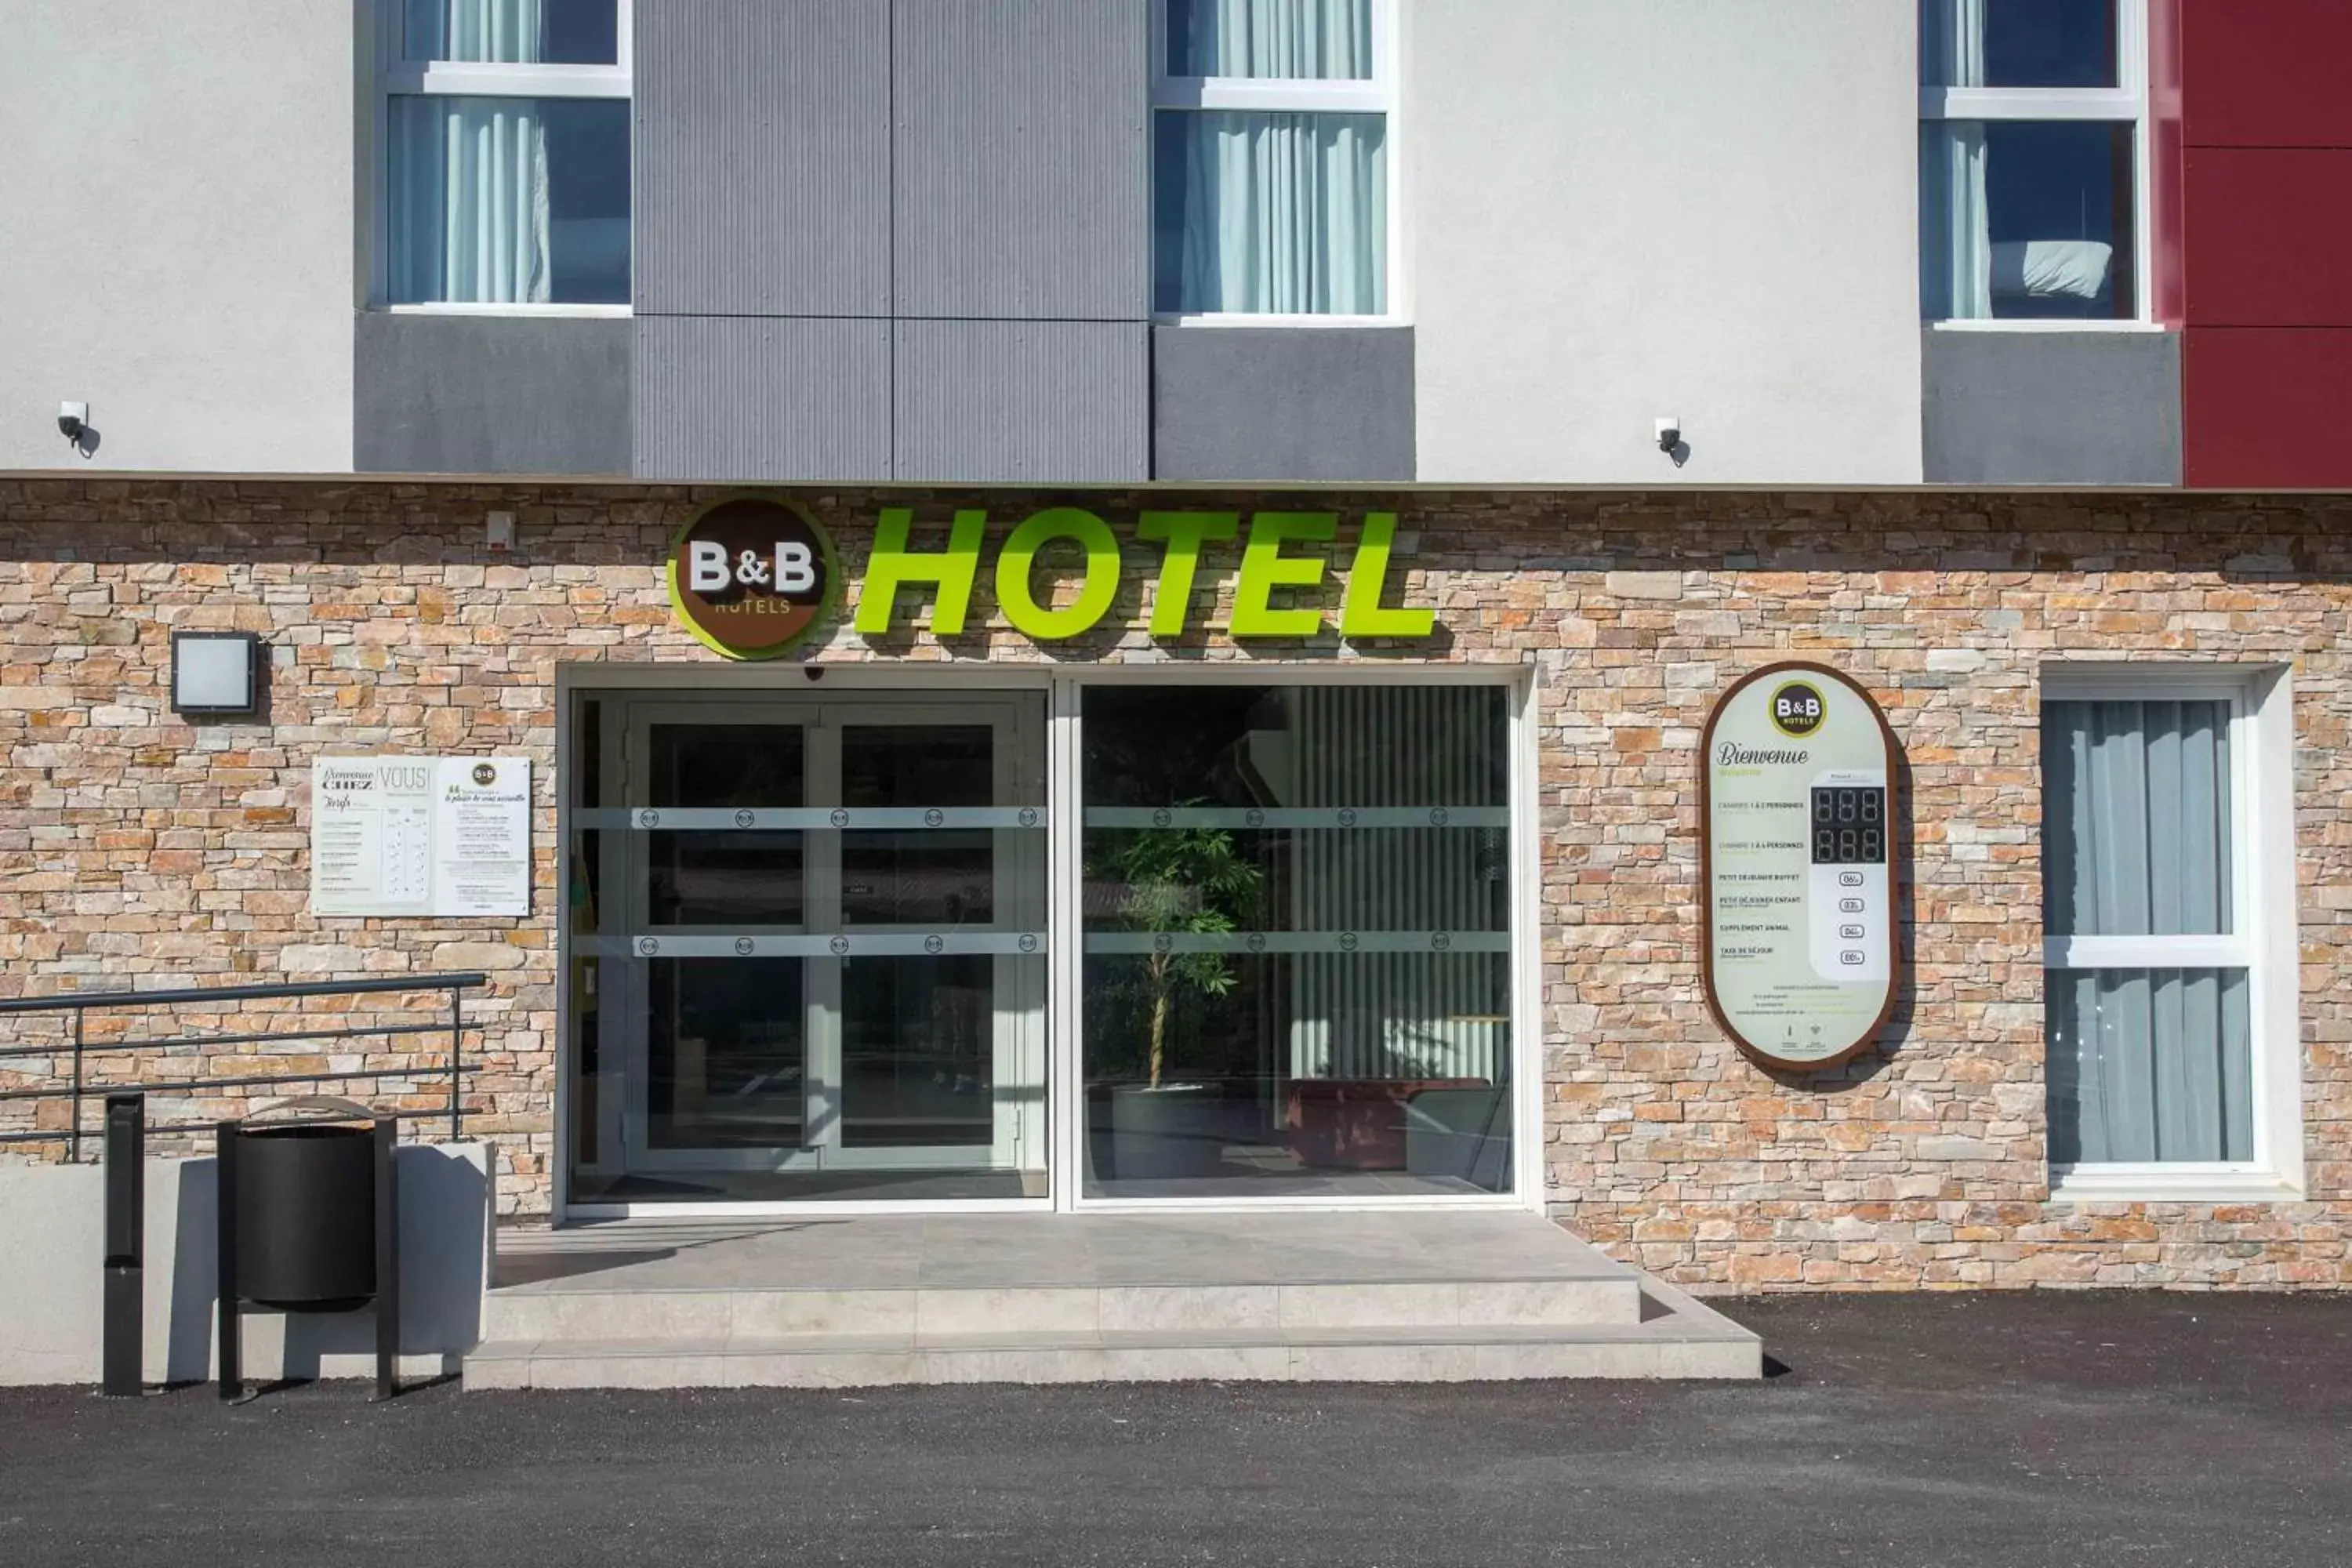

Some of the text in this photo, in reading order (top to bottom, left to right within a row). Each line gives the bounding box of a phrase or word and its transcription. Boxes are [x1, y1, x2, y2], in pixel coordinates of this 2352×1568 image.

[690, 540, 815, 591] B&B
[855, 507, 1434, 640] HOTEL
[714, 600, 790, 615] HOTELS
[1777, 699, 1820, 717] B&B
[1717, 741, 1809, 766] Bienvenue
[380, 767, 426, 789] VOUS
